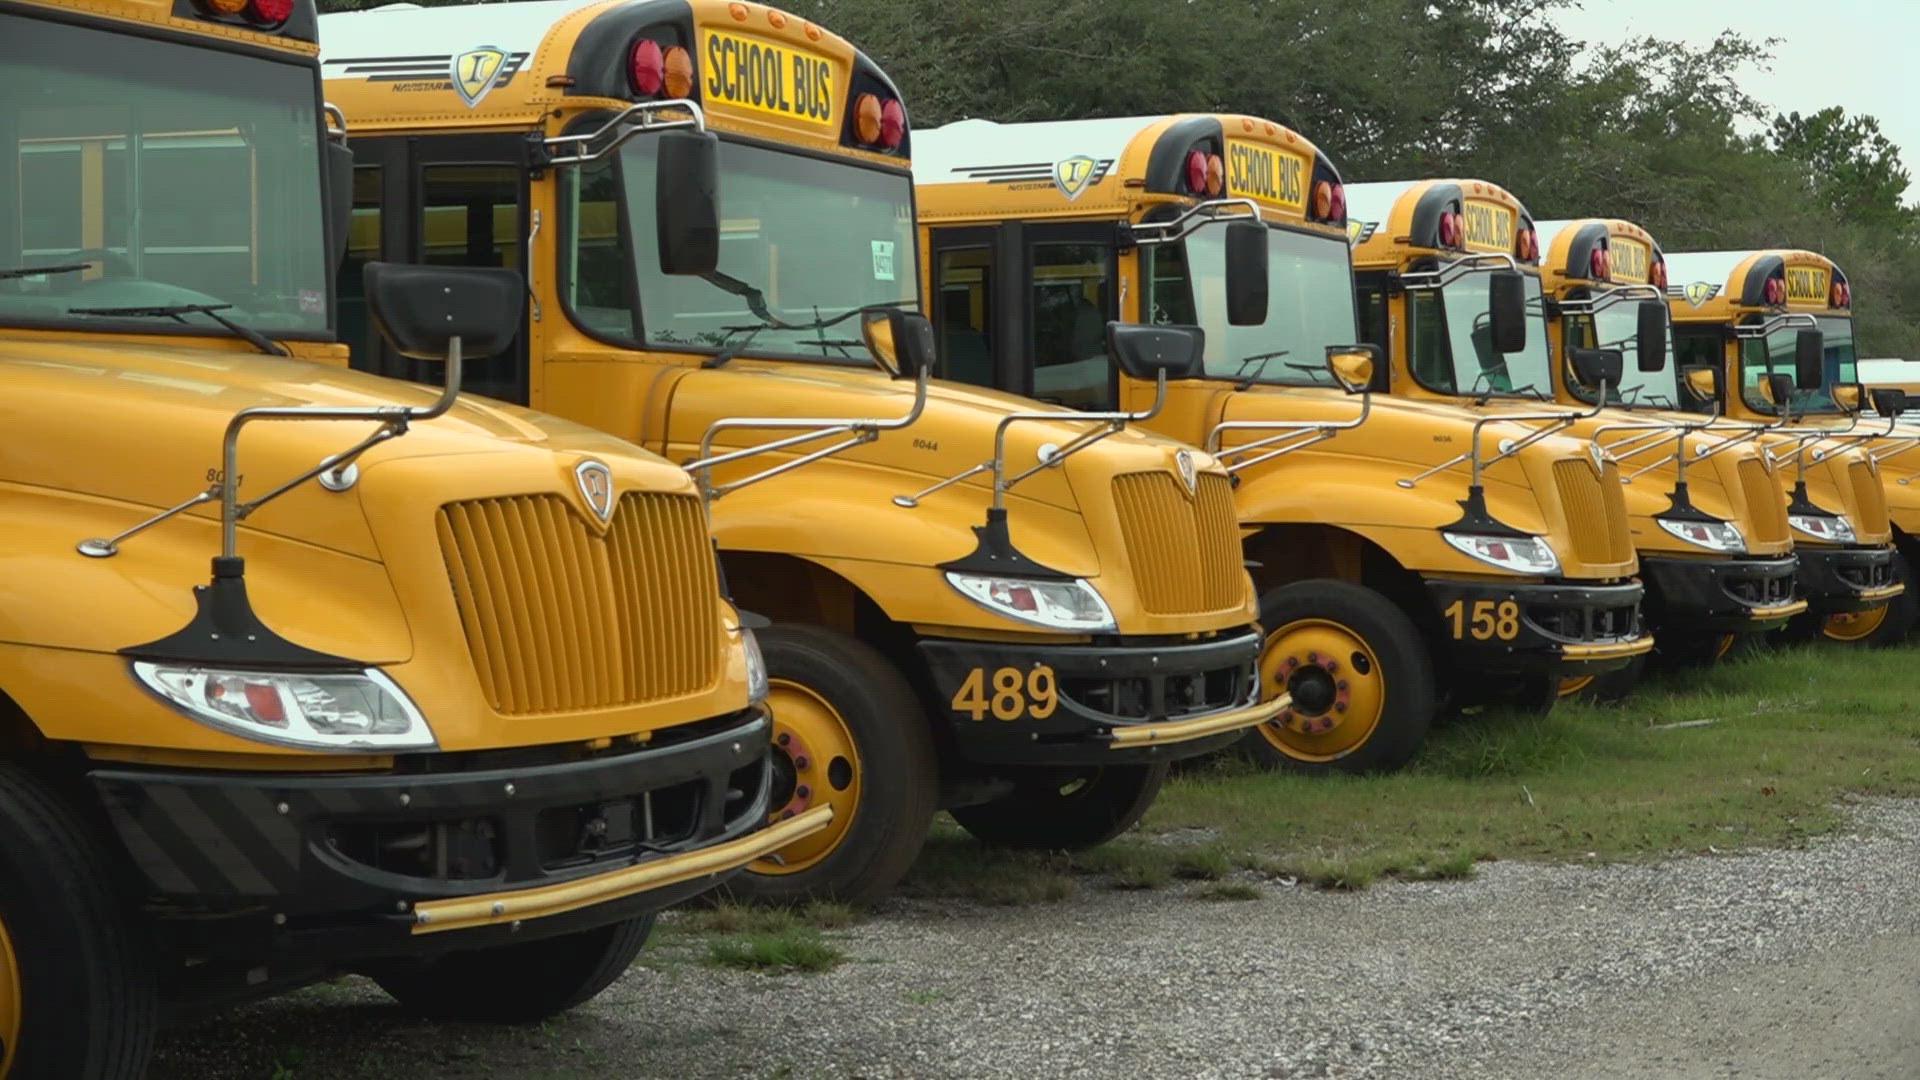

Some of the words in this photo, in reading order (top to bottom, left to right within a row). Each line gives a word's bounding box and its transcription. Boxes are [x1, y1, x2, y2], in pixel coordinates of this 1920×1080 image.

[392, 82, 442, 92] NAVISTAR
[708, 34, 789, 111] SCHOOL
[793, 54, 830, 121] BUS
[1230, 143, 1276, 198] SCHOOL
[1279, 155, 1300, 204] BUS
[1466, 203, 1495, 246] SCHOOL
[1496, 209, 1509, 249] BUS
[1611, 240, 1633, 277] SCHOOL
[1634, 246, 1645, 280] BUS
[1788, 269, 1812, 298] SCHOOL
[1813, 271, 1825, 299] BUS
[912, 438, 938, 451] 8044
[206, 468, 244, 487] 801
[1444, 600, 1519, 640] 158
[951, 665, 1057, 720] 489
